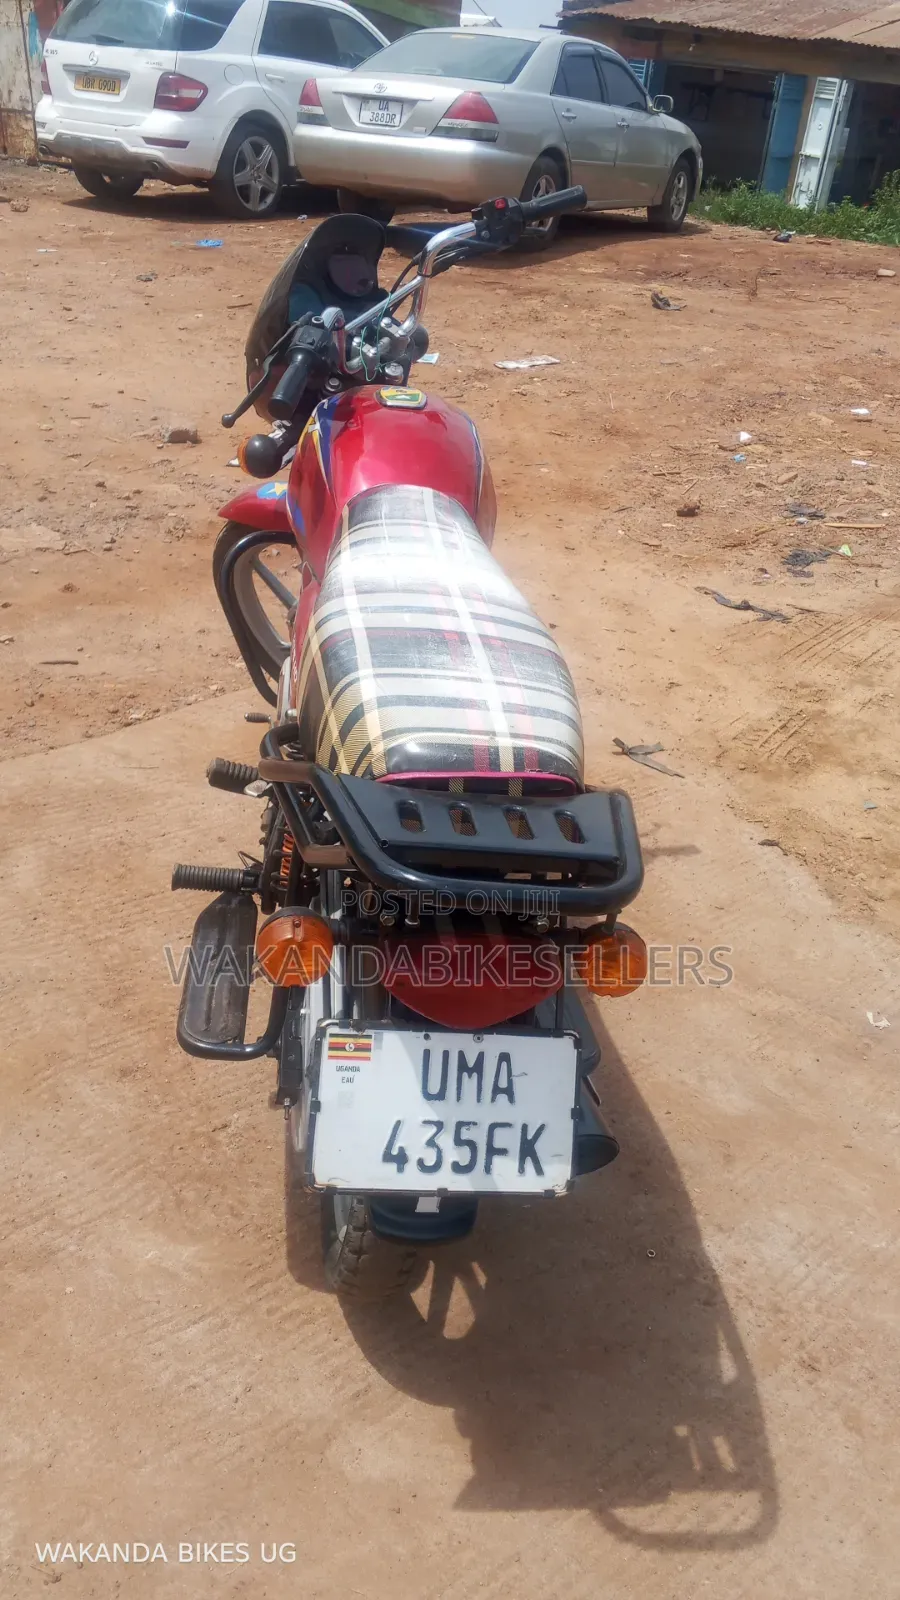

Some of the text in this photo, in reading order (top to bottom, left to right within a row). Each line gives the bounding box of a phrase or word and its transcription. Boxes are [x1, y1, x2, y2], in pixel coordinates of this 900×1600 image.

[378, 100, 389, 112] UA
[369, 111, 397, 124] 388DR
[336, 1065, 361, 1073] UGANDA
[421, 1048, 515, 1105] UMA
[382, 1119, 546, 1176] 435FK
